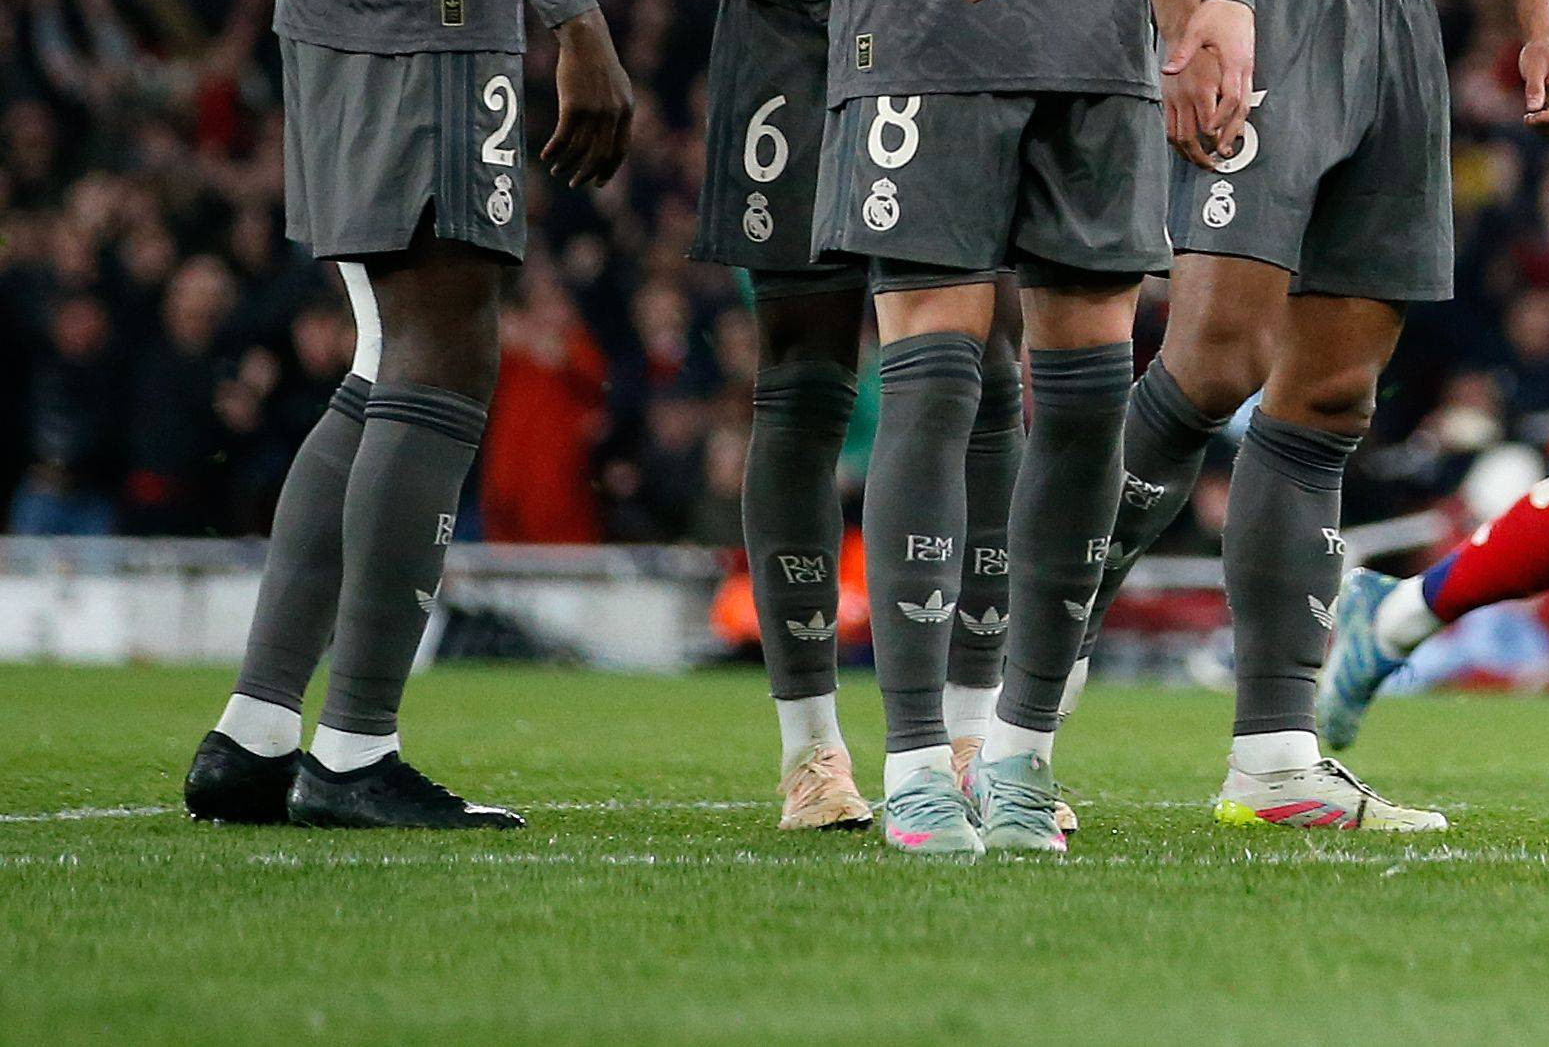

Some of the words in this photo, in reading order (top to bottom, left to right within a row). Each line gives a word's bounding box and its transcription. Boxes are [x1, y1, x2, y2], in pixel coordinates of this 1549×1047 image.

[481, 74, 518, 167] 2
[743, 94, 789, 183] 6
[866, 95, 921, 169] 8
